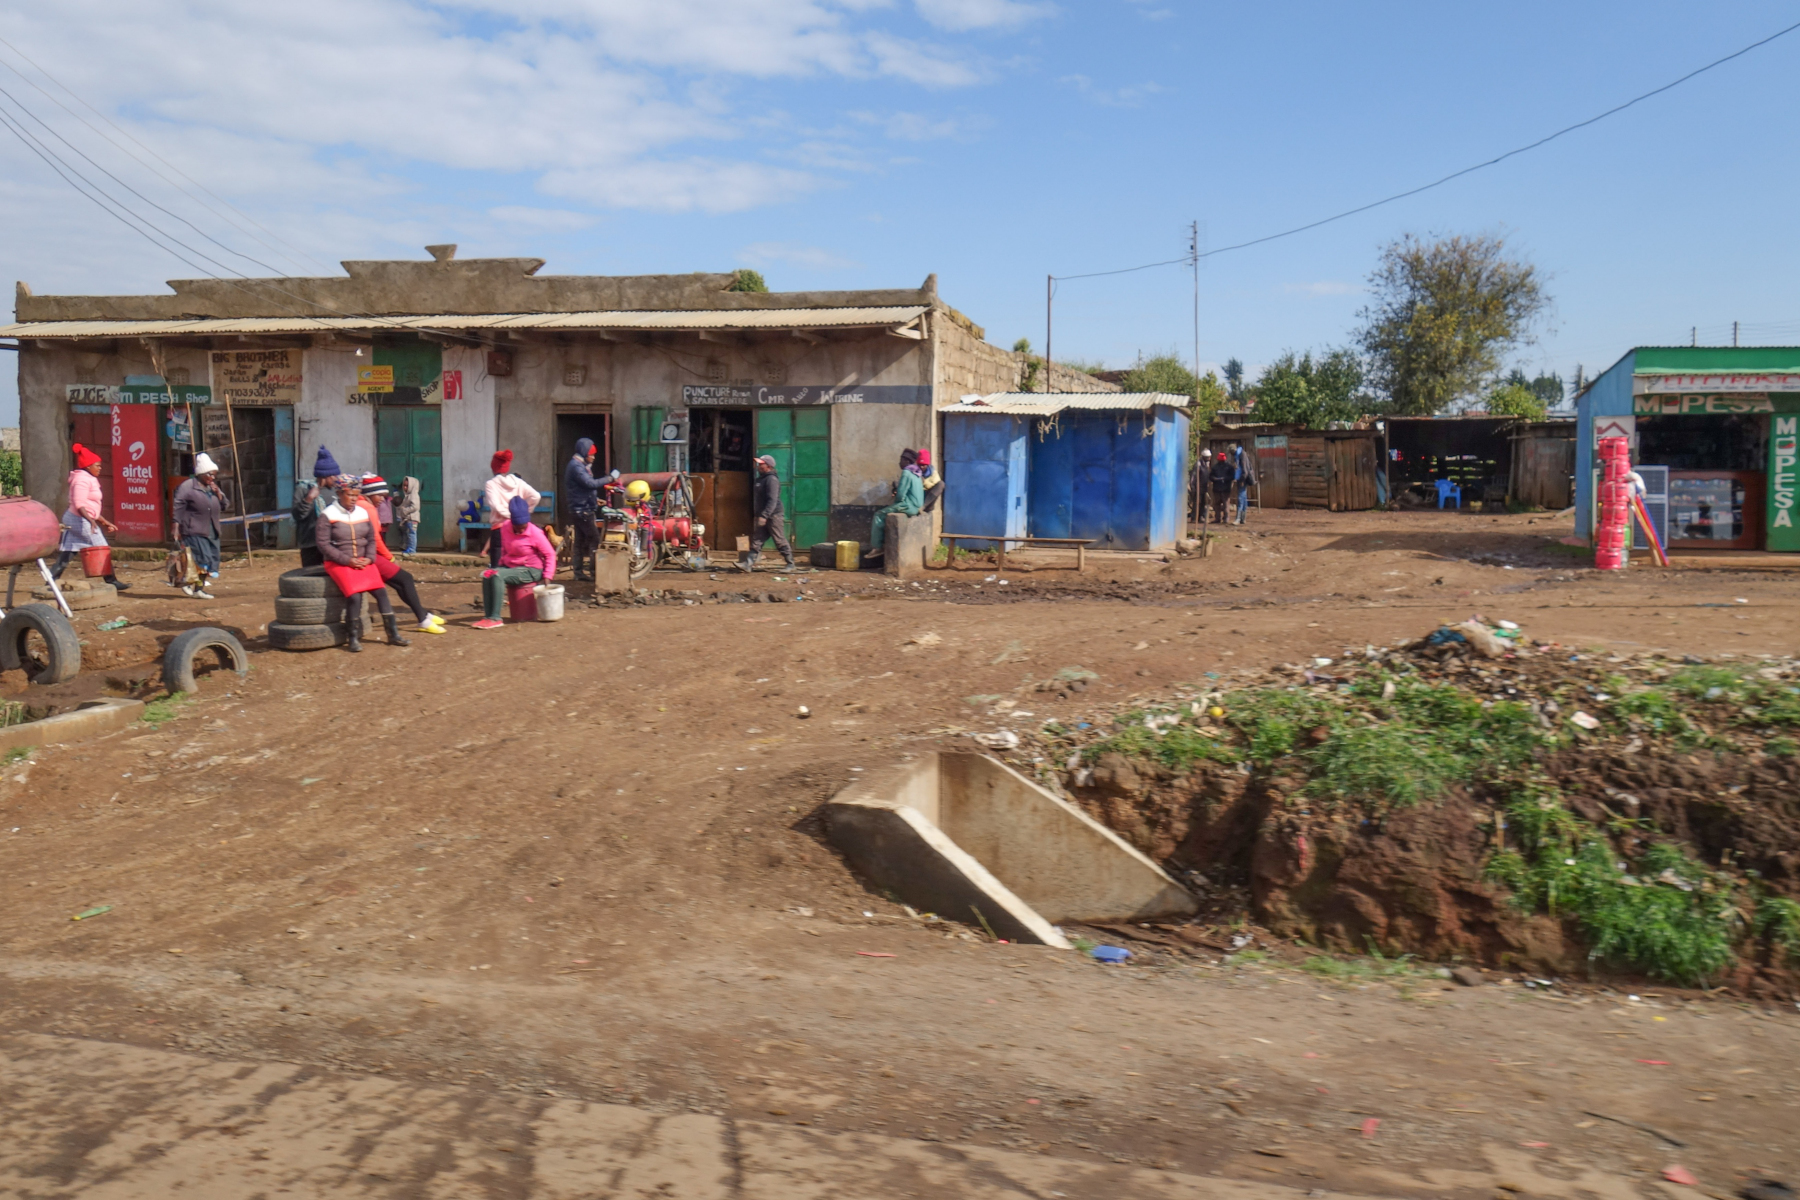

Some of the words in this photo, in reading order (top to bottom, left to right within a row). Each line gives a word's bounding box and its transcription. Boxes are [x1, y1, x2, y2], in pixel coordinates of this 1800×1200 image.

[212, 352, 229, 363] BIG
[236, 351, 288, 362] BROTHER
[683, 387, 730, 403] PUNCTURE
[757, 387, 785, 404] CMR
[123, 464, 152, 478] airtel
